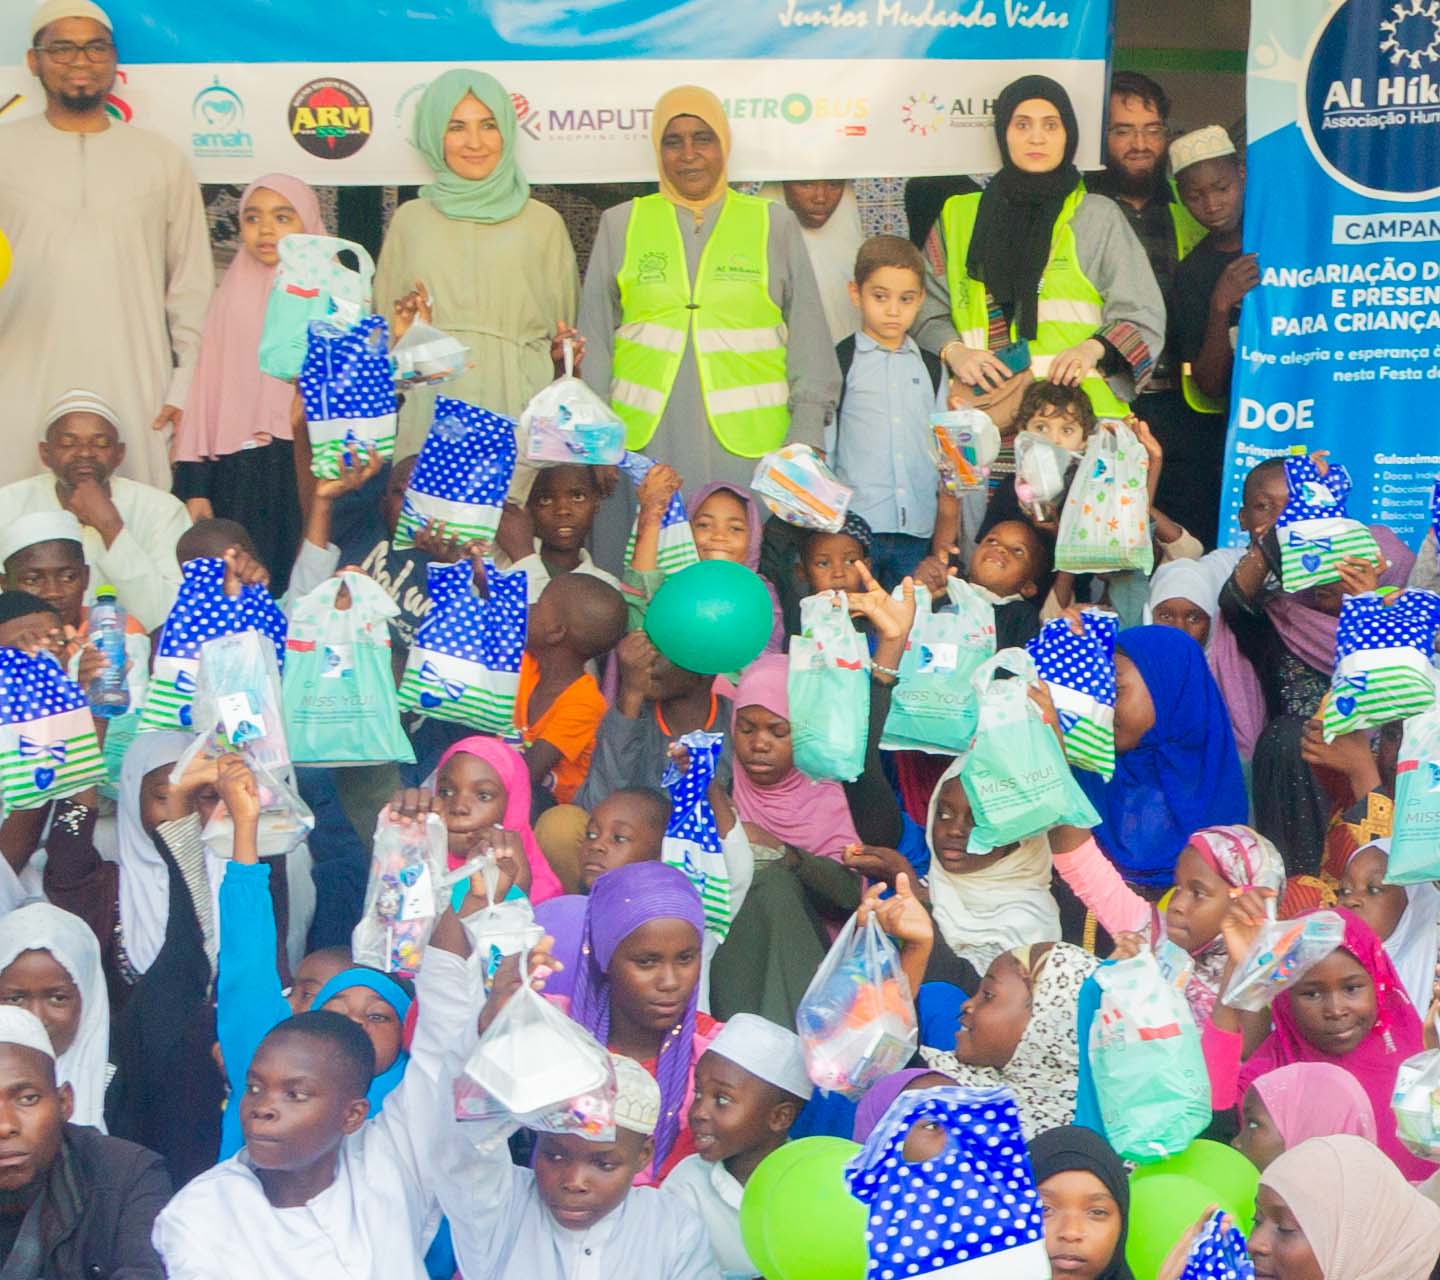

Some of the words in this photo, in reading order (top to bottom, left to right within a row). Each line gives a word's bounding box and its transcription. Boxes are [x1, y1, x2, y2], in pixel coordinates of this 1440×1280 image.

[1323, 77, 1365, 111] Al
[291, 106, 372, 135] ARM
[548, 108, 655, 131] MAPUT
[1321, 111, 1407, 131] Associação
[1261, 257, 1417, 288] ANGARIAÇÃO
[1331, 288, 1347, 308] E
[1271, 313, 1329, 337] PARA
[1241, 346, 1277, 365] Leve
[1280, 347, 1331, 368] alegria
[1334, 350, 1345, 361] e
[1348, 348, 1430, 363] esperança
[1333, 369, 1376, 383] nesta
[1379, 366, 1424, 381] Festa
[1238, 397, 1315, 432] DOE
[1236, 440, 1291, 458] Brinqued
[980, 776, 1017, 796] MISS
